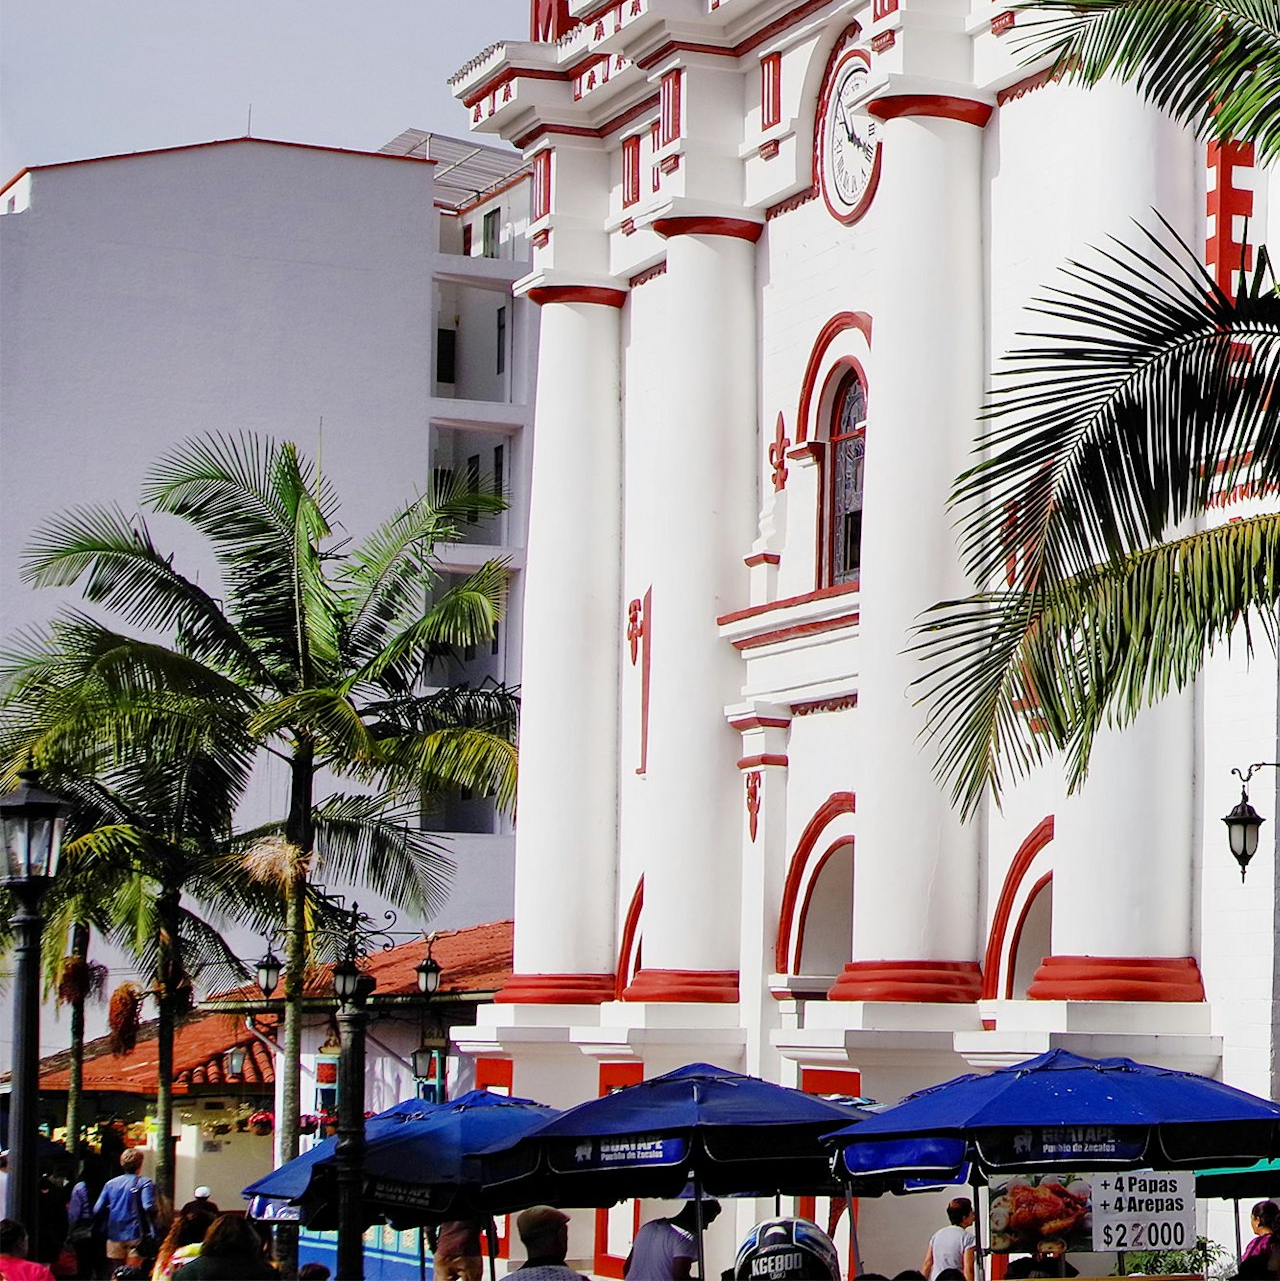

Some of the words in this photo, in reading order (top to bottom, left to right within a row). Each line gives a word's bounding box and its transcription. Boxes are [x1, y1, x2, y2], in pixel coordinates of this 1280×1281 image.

[1043, 1143, 1071, 1153] Pueblo
[1072, 1143, 1082, 1152] de
[1114, 1176, 1125, 1193] 4
[1128, 1176, 1178, 1195] Papas
[1113, 1196, 1124, 1213] 4
[1127, 1196, 1185, 1214] Arepas
